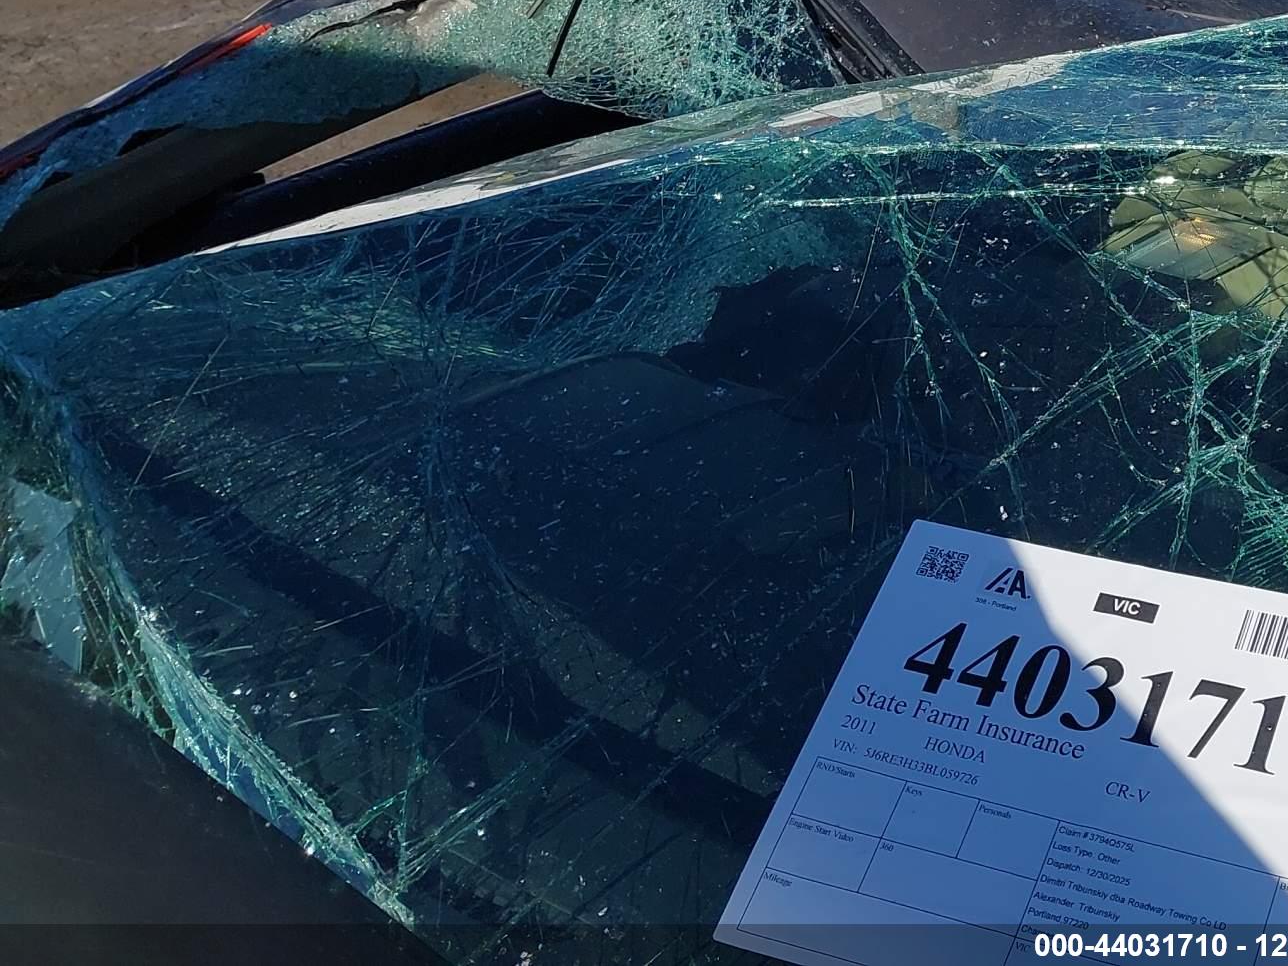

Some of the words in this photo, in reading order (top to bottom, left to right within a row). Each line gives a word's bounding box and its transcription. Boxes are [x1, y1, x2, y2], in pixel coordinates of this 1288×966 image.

[992, 600, 1017, 611] Portland
[1113, 598, 1142, 615] VIC
[840, 714, 877, 735] 2011
[851, 684, 908, 715] State
[911, 699, 970, 732] Farm
[975, 714, 1086, 760] Insurance
[923, 736, 986, 764] HONDA
[815, 760, 856, 779] RND/Starts
[832, 737, 858, 754] VIN:
[863, 747, 981, 786] 5J6RE3H33BL059726
[904, 785, 924, 797] Keys
[1104, 781, 1152, 804] CR-V
[977, 803, 1013, 821] Personals
[788, 817, 815, 831] Engine
[814, 825, 832, 836] Start
[834, 829, 854, 843] Video
[1058, 825, 1081, 839] Claim
[880, 841, 894, 852] 360
[1052, 841, 1072, 853] Loss
[1097, 852, 1121, 866] Other
[763, 871, 793, 887] Mileage
[1086, 867, 1132, 887] 12/30/2025
[1033, 891, 1075, 909] Alexander
[1109, 893, 1126, 904] dba
[1127, 897, 1167, 917] Roadway
[1169, 908, 1198, 925] Towing
[1199, 916, 1212, 928] Co
